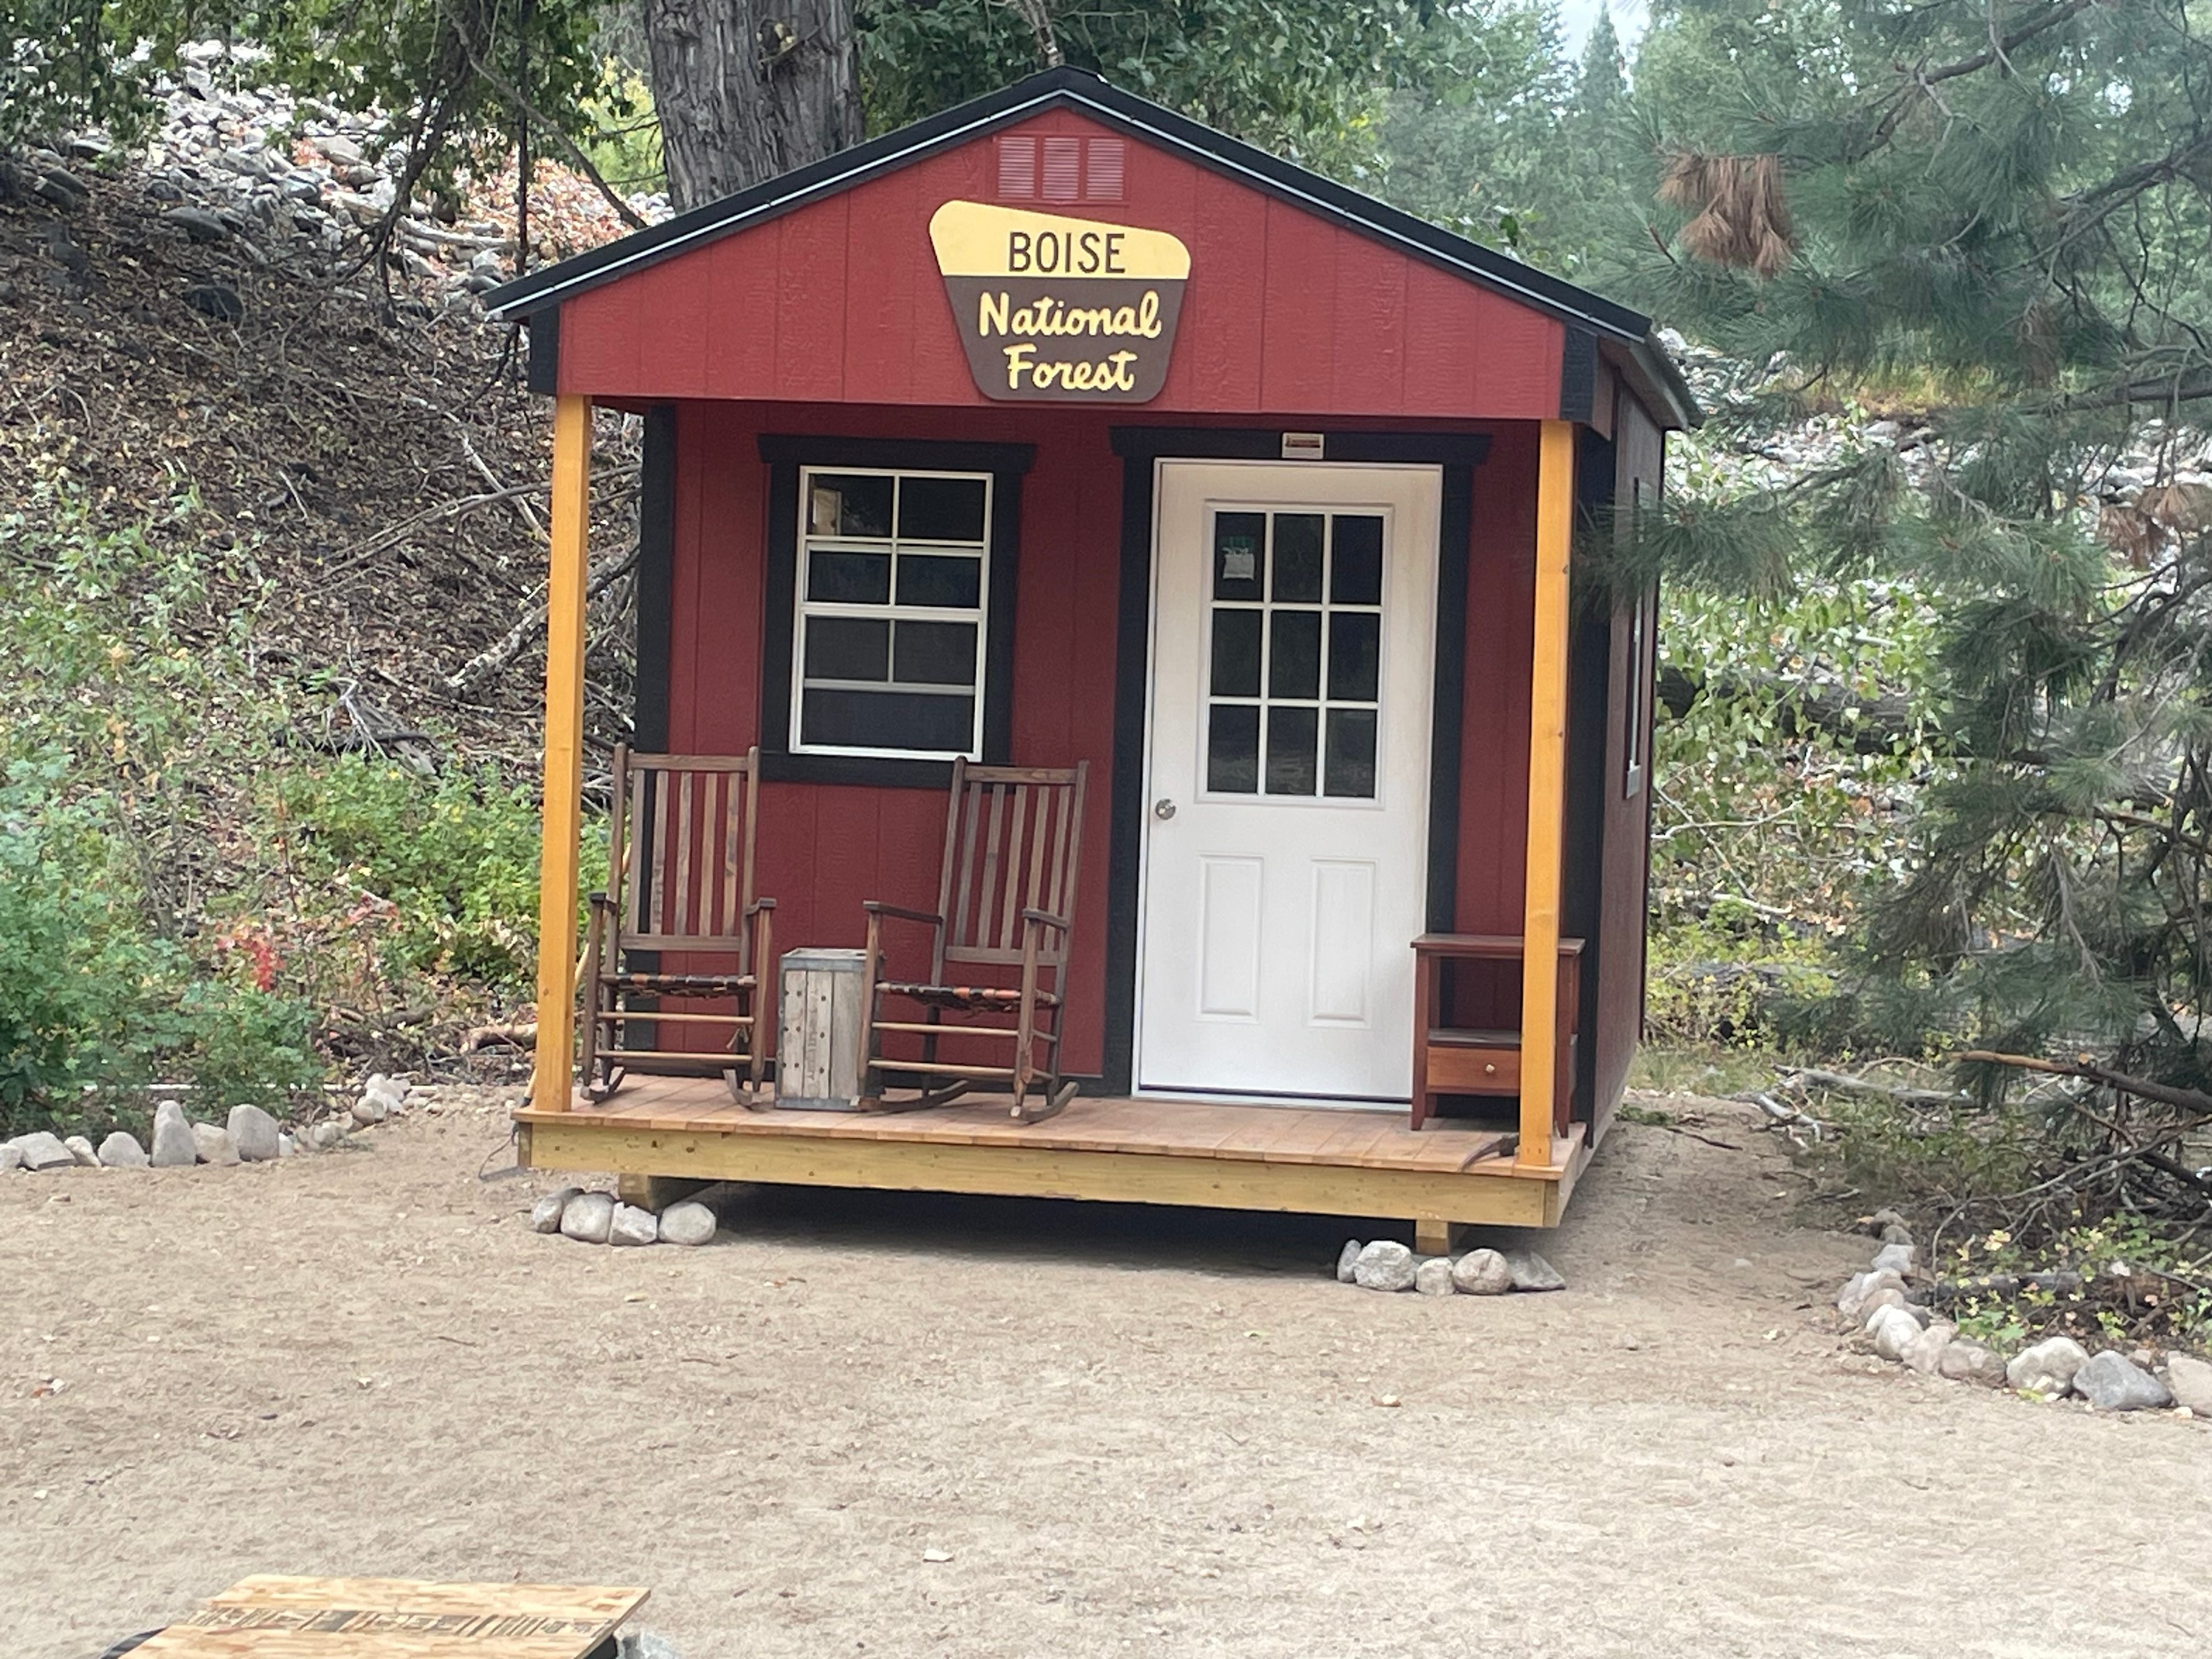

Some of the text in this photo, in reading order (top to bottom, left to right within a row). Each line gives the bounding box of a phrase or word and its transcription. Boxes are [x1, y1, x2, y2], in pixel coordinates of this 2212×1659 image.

[1008, 232, 1126, 274] BOISE
[979, 290, 1162, 339] National
[1003, 343, 1138, 391] Forest
